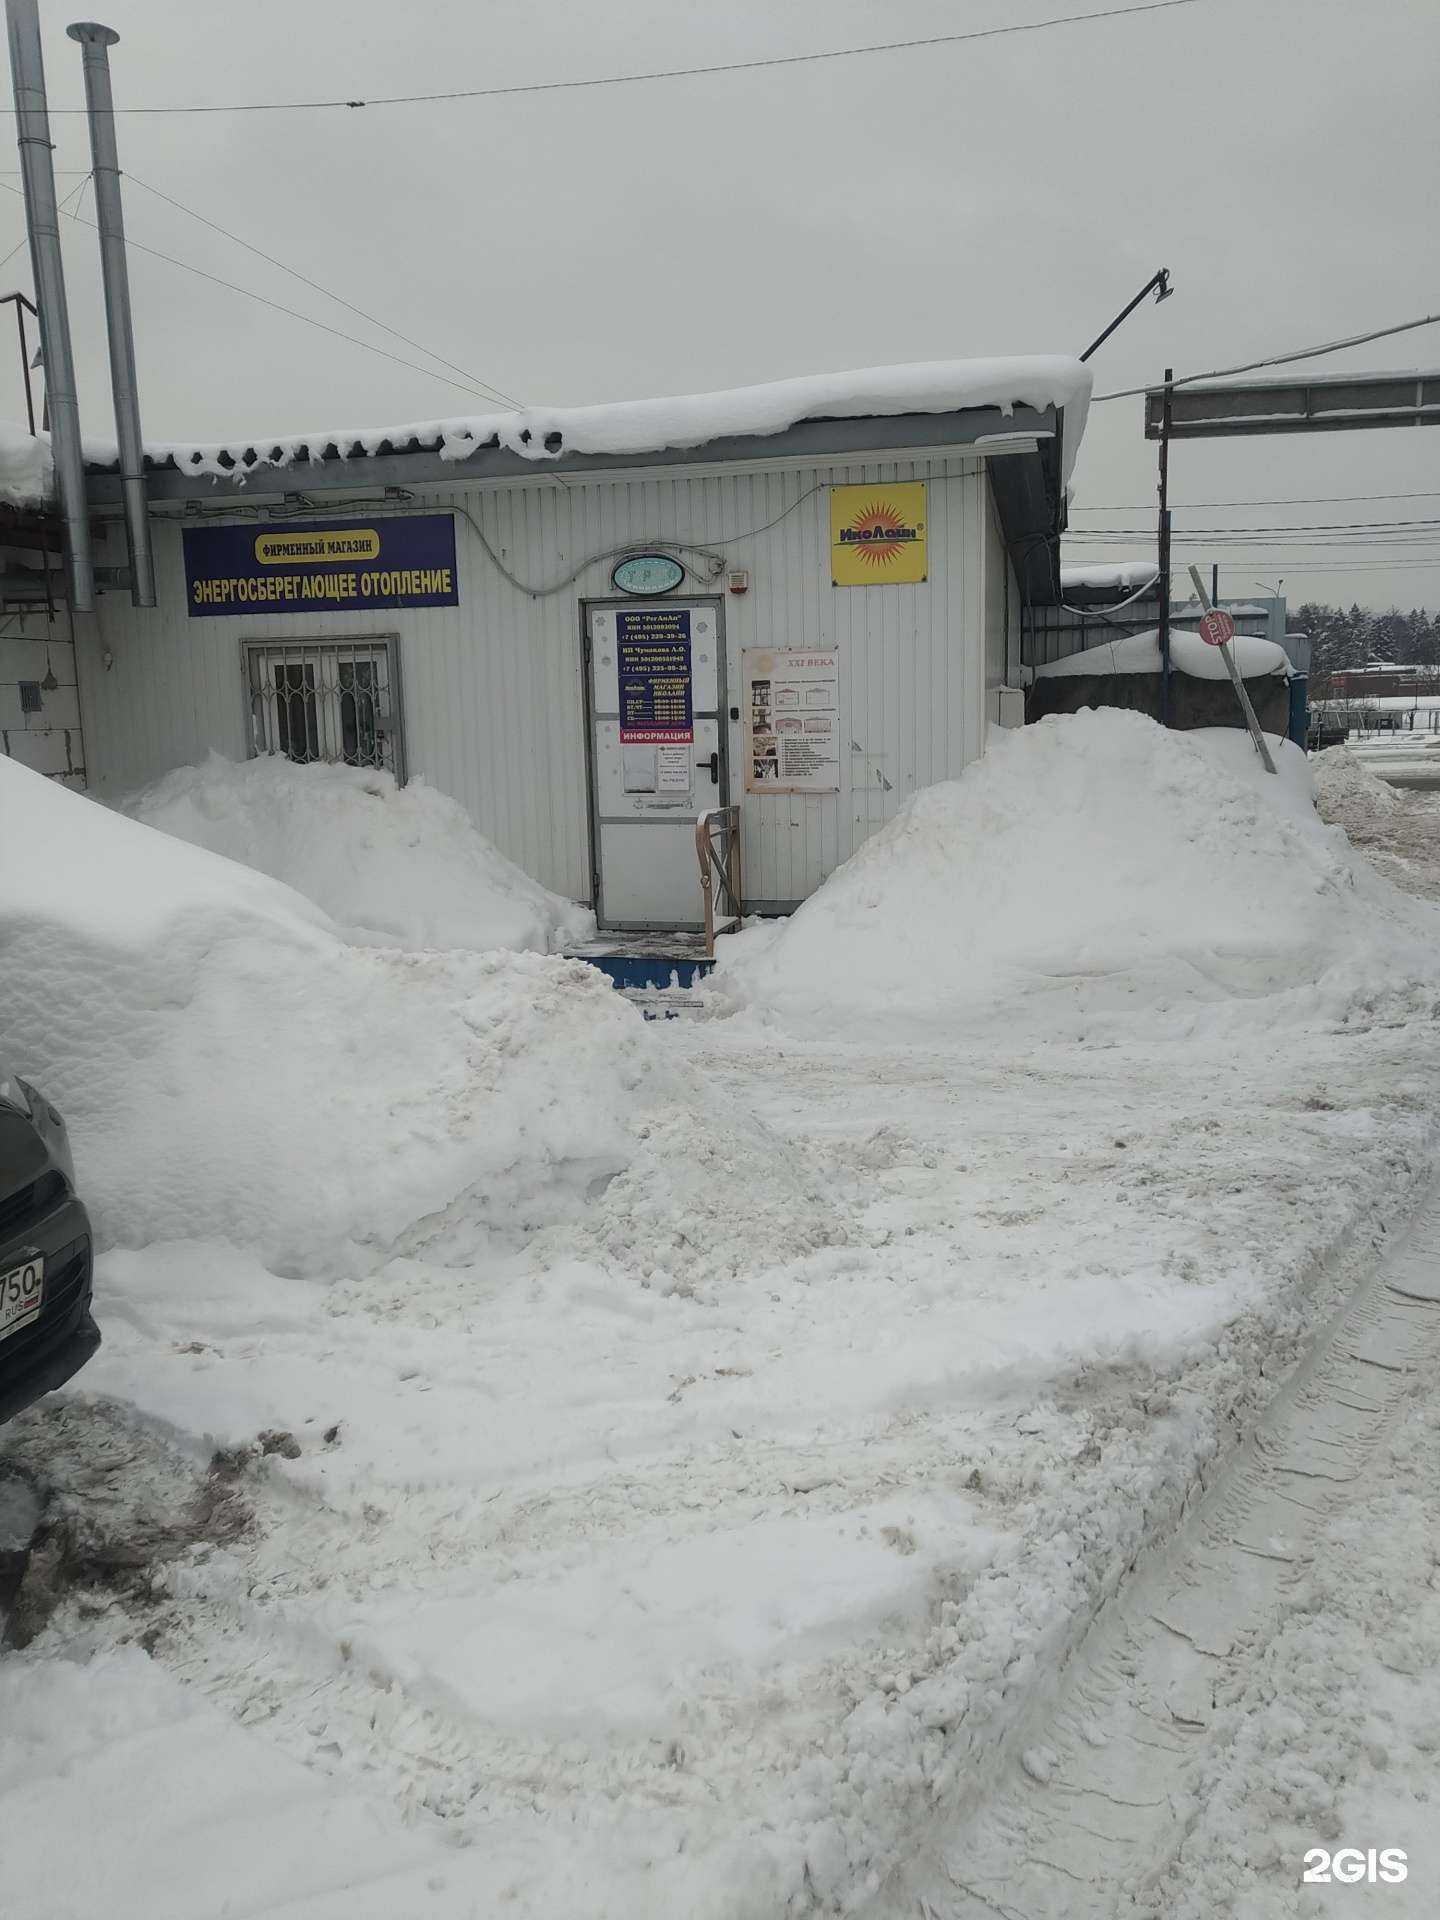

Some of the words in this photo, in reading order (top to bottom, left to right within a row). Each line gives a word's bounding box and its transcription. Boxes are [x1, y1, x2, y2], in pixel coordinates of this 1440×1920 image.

[262, 539, 325, 557] ФИРМЕННЫЙ
[327, 539, 373, 554] МАГАЗИН
[194, 573, 357, 603] ЭНЕРГОСБЕРЕГАЮЩЕЕ
[361, 568, 451, 596] ОТОПЛЕНИЕ
[5, 1301, 24, 1320] RUS
